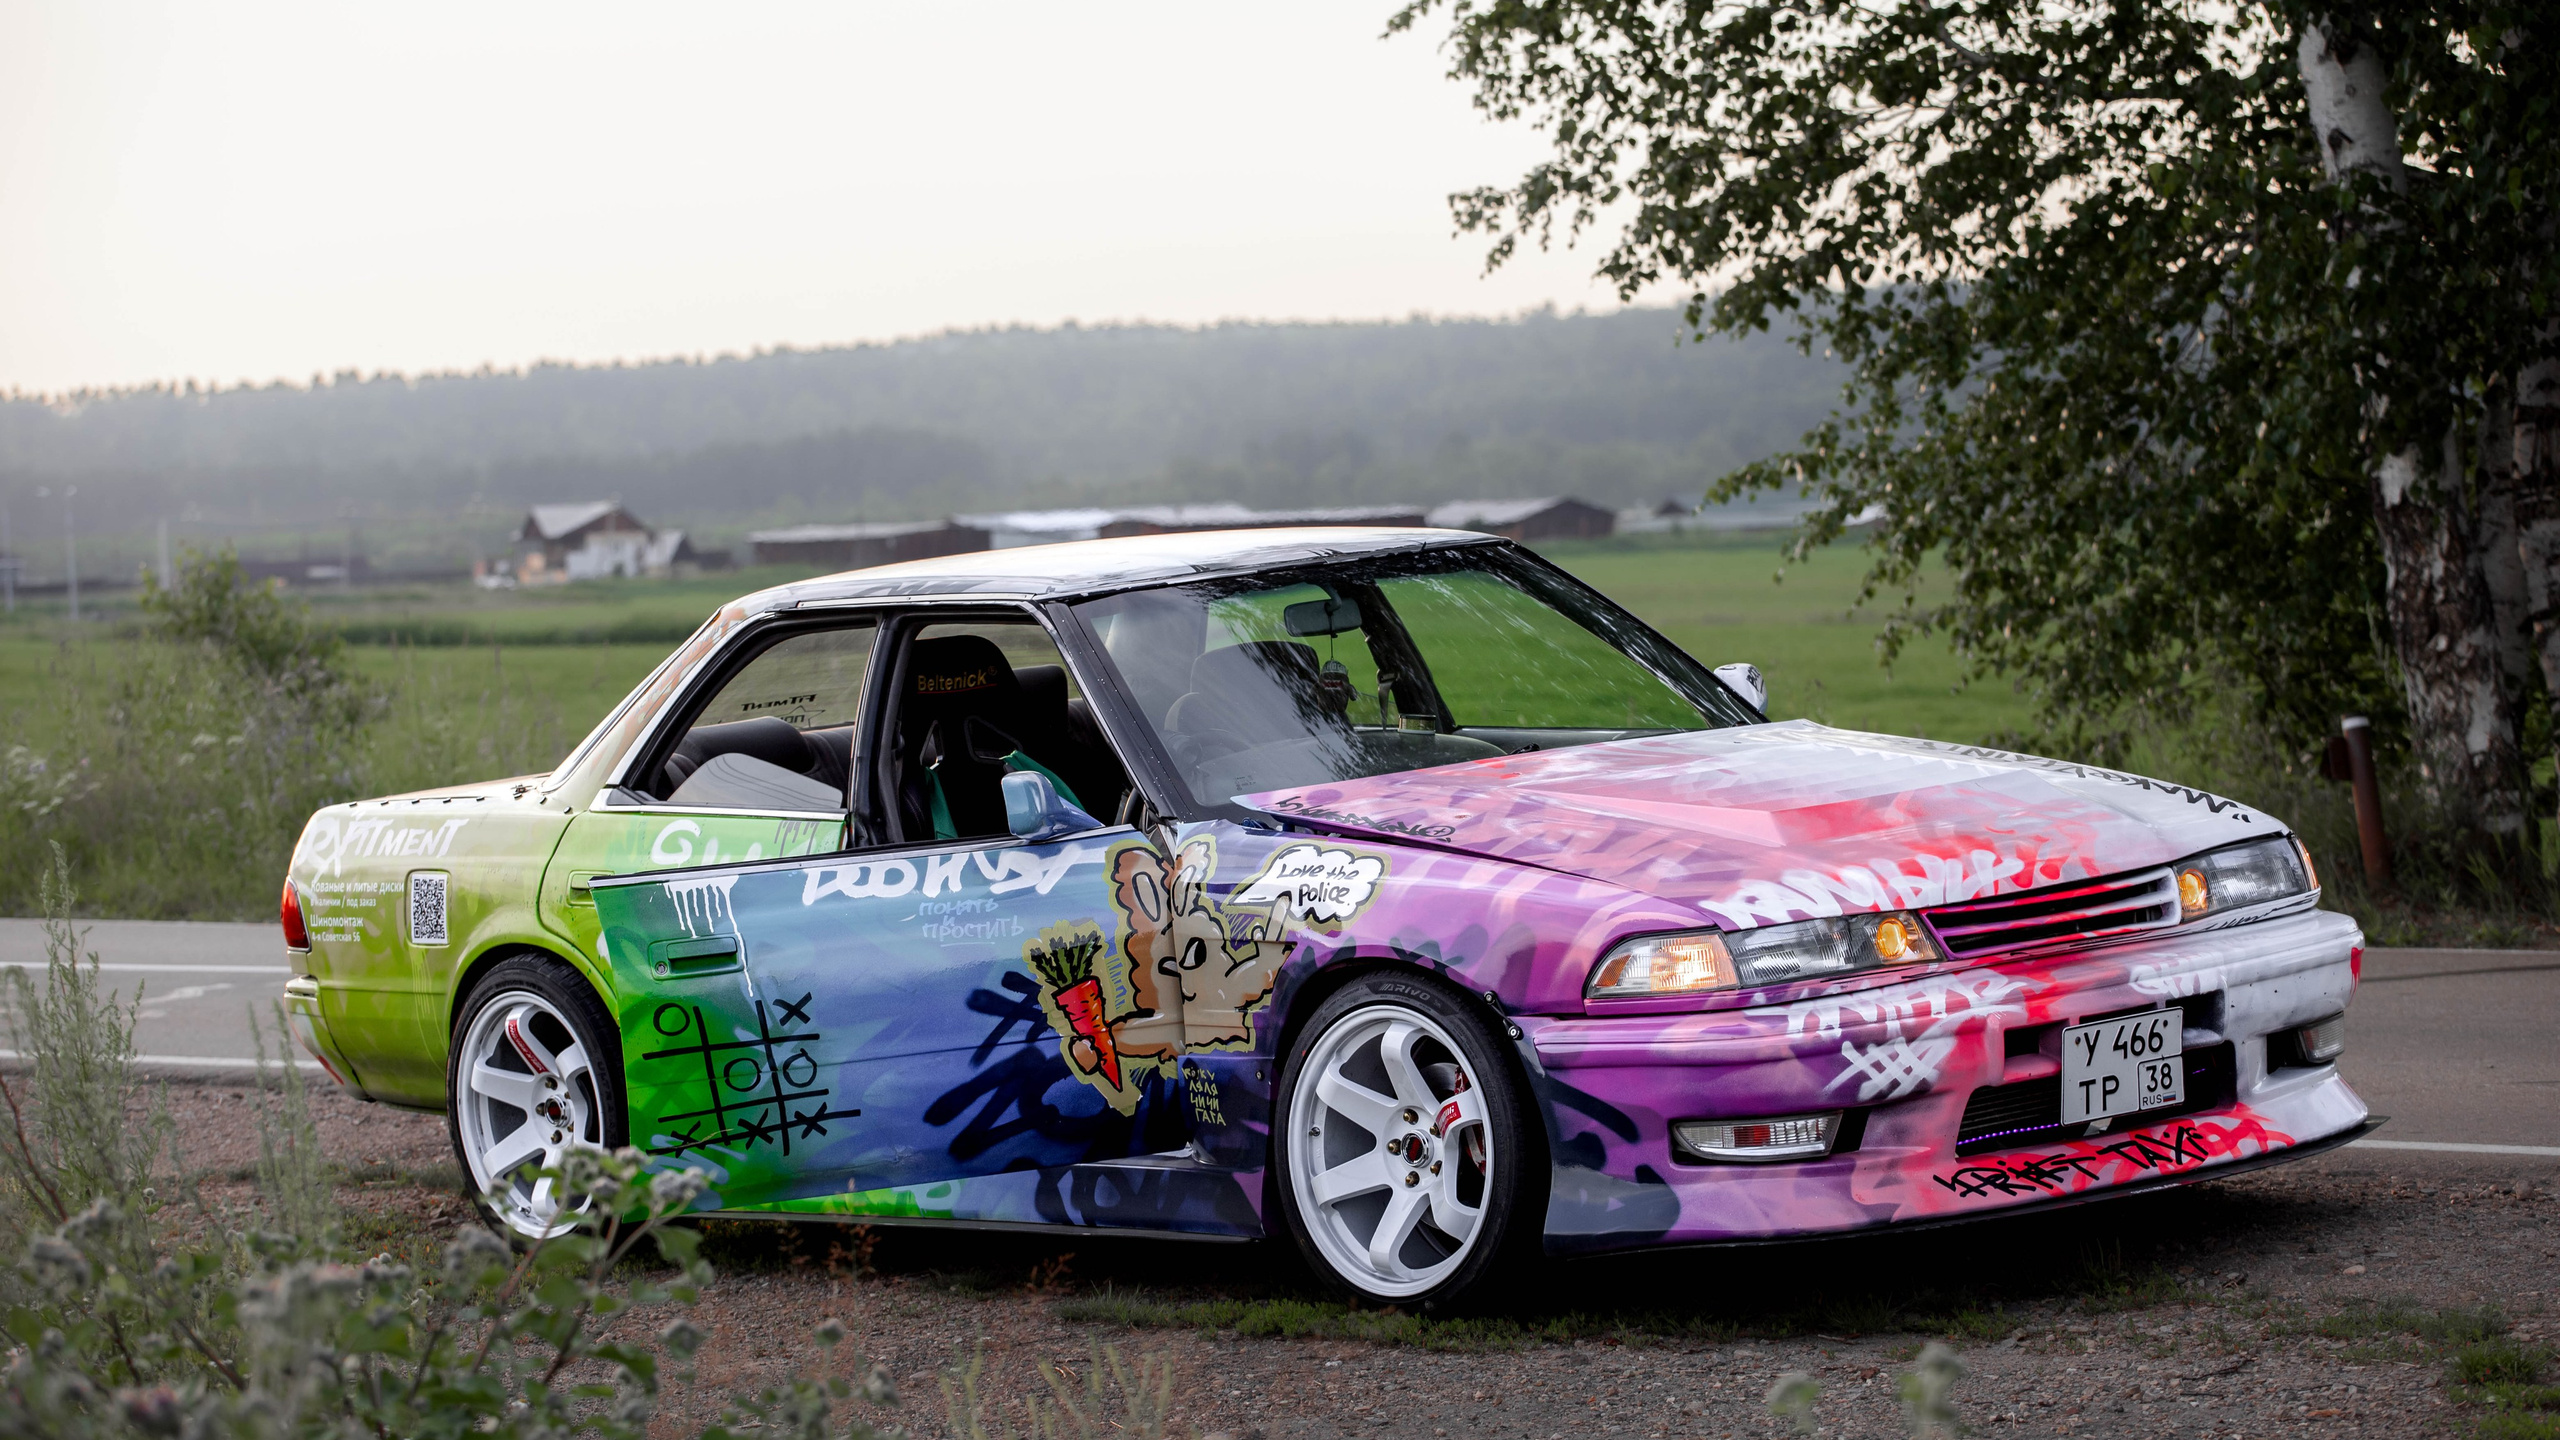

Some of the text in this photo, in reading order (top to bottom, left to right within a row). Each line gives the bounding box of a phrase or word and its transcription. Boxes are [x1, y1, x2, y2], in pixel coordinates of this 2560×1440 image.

[917, 669, 987, 691] Beltenick
[1276, 863, 1360, 881] Love the
[346, 883, 352, 892] и
[353, 883, 378, 893] литые
[379, 882, 405, 895] диски
[346, 899, 358, 908] под
[359, 899, 377, 907] заказ
[310, 914, 364, 927] Шиномонтаж
[322, 932, 352, 941] Советская
[353, 931, 361, 942] 56
[1380, 983, 1431, 1001] ARIVO
[2112, 1018, 2164, 1060] 466
[2145, 1062, 2173, 1093] 38
[2142, 1094, 2163, 1106] RUS
[1195, 1107, 1227, 1127] ГАГА
